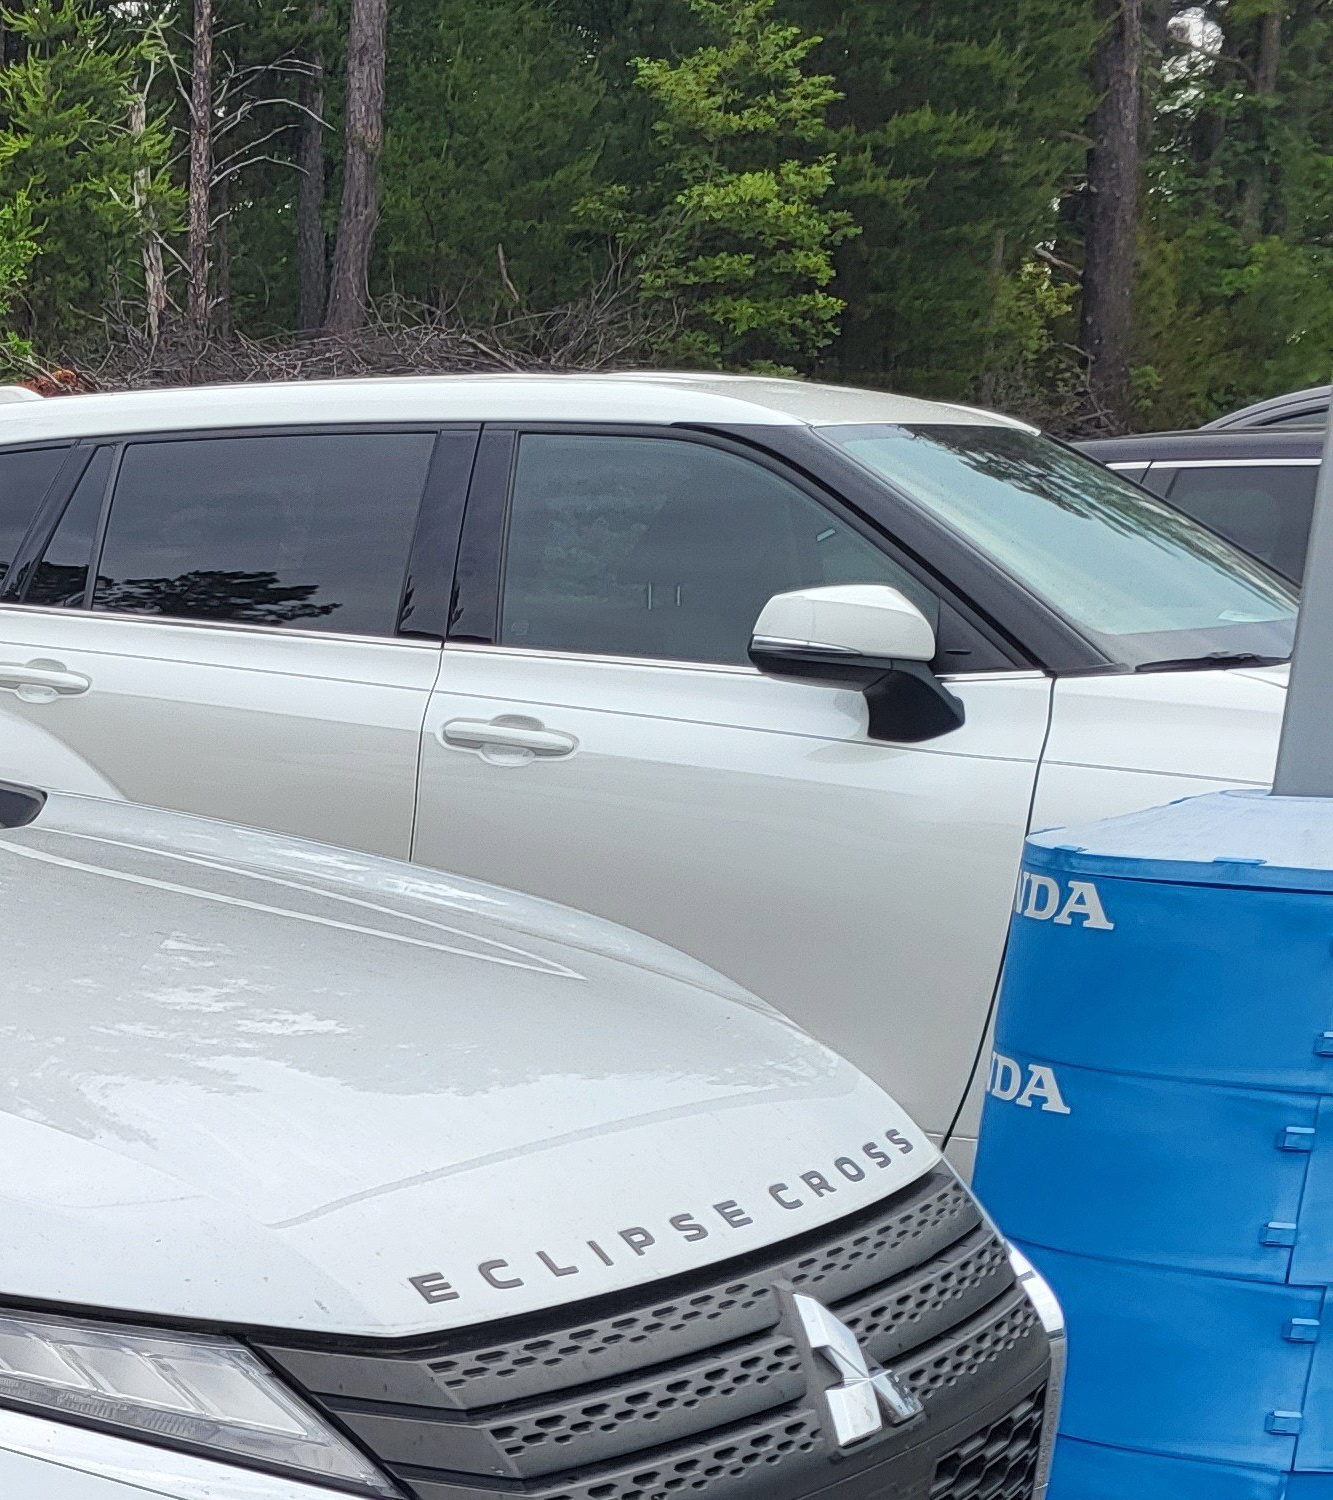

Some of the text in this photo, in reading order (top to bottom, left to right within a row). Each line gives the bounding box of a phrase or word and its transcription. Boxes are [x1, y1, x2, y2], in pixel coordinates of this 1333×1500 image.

[986, 1051, 1071, 1115] DA
[408, 1127, 916, 1305] ECLIPSE CROSS
